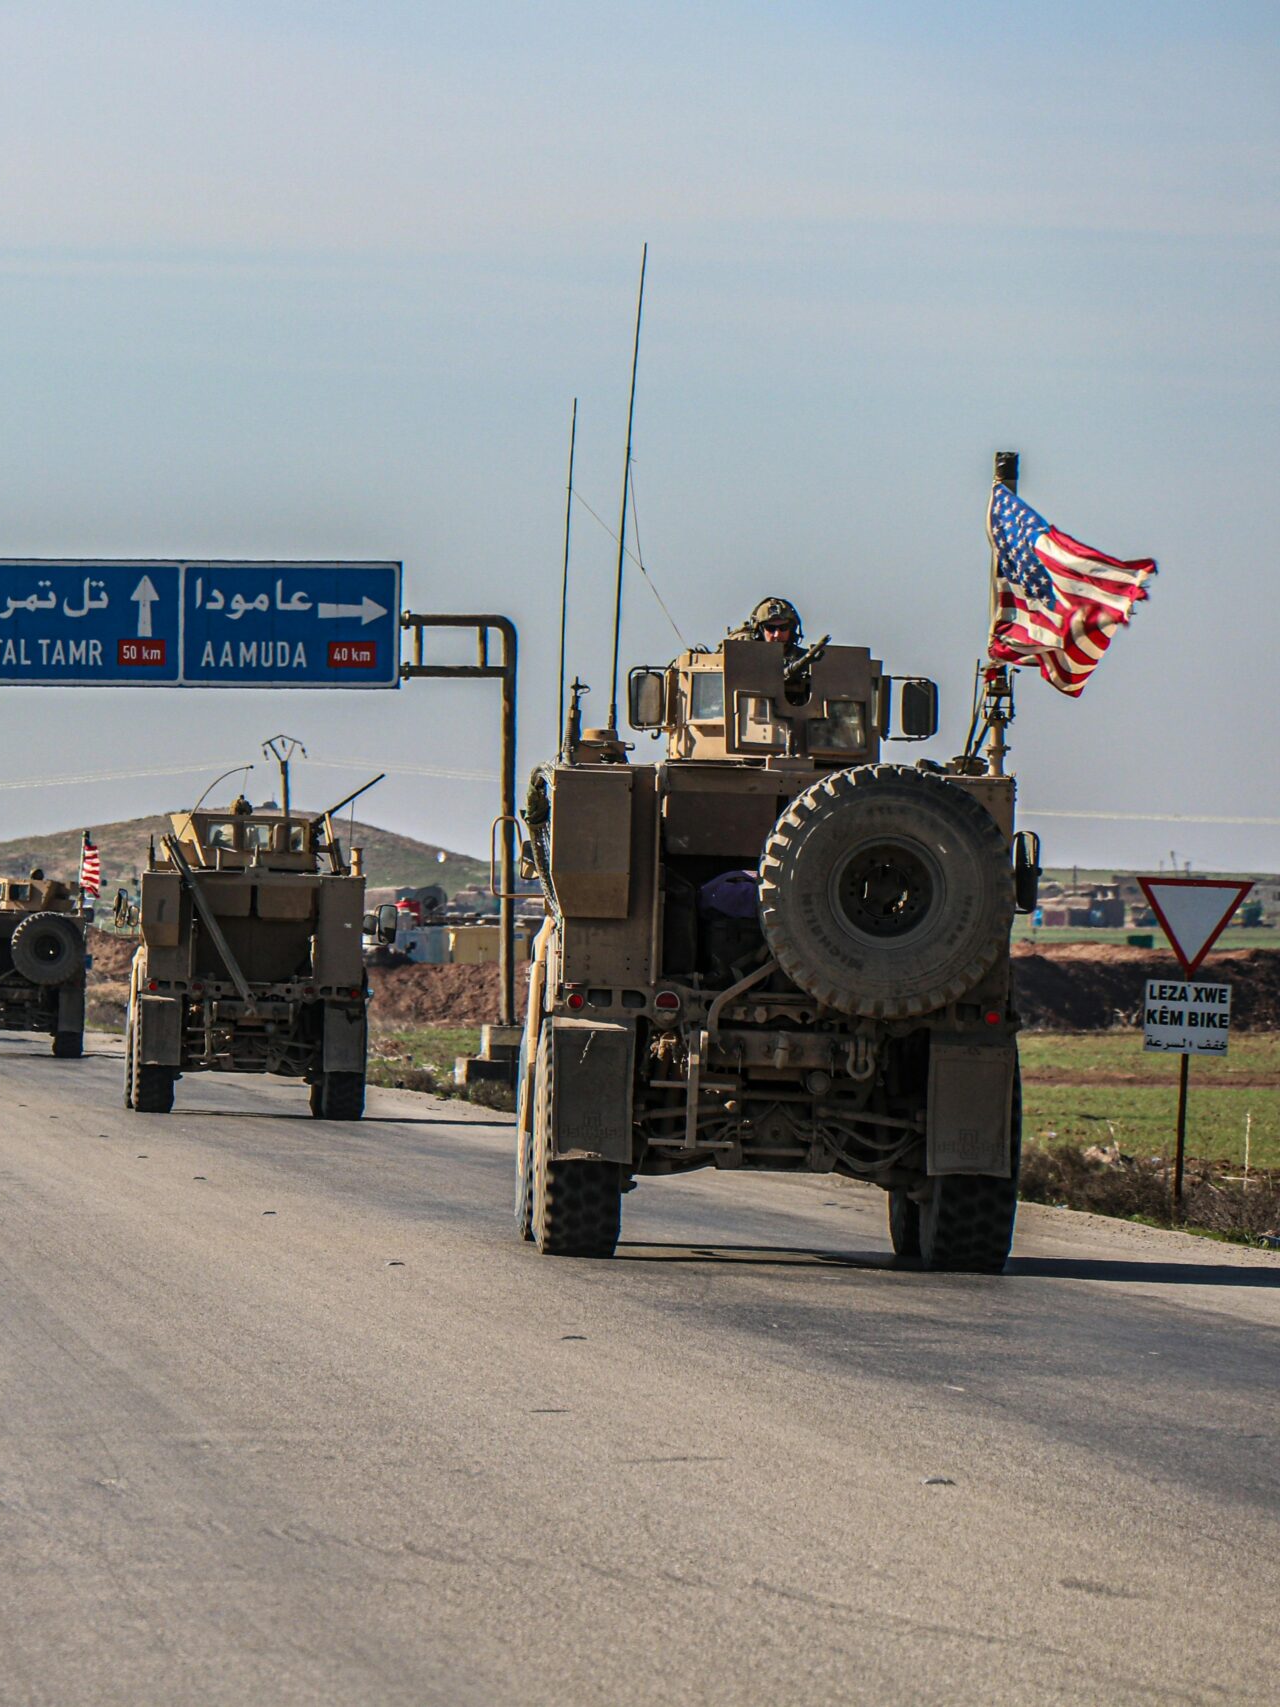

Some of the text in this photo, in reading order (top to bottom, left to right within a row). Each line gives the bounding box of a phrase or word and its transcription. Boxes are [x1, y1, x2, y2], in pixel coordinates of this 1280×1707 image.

[63, 576, 109, 618] تل
[195, 577, 313, 620] عامودا
[37, 639, 103, 666] TAMR
[122, 645, 161, 660] 50 km
[200, 640, 307, 668] AAMUDA
[333, 647, 371, 662] 40 km
[1149, 984, 1228, 1004] LEZA XWE
[1146, 1005, 1229, 1029] KÊM BIKE
[1146, 1034, 1193, 1050] السرعة
